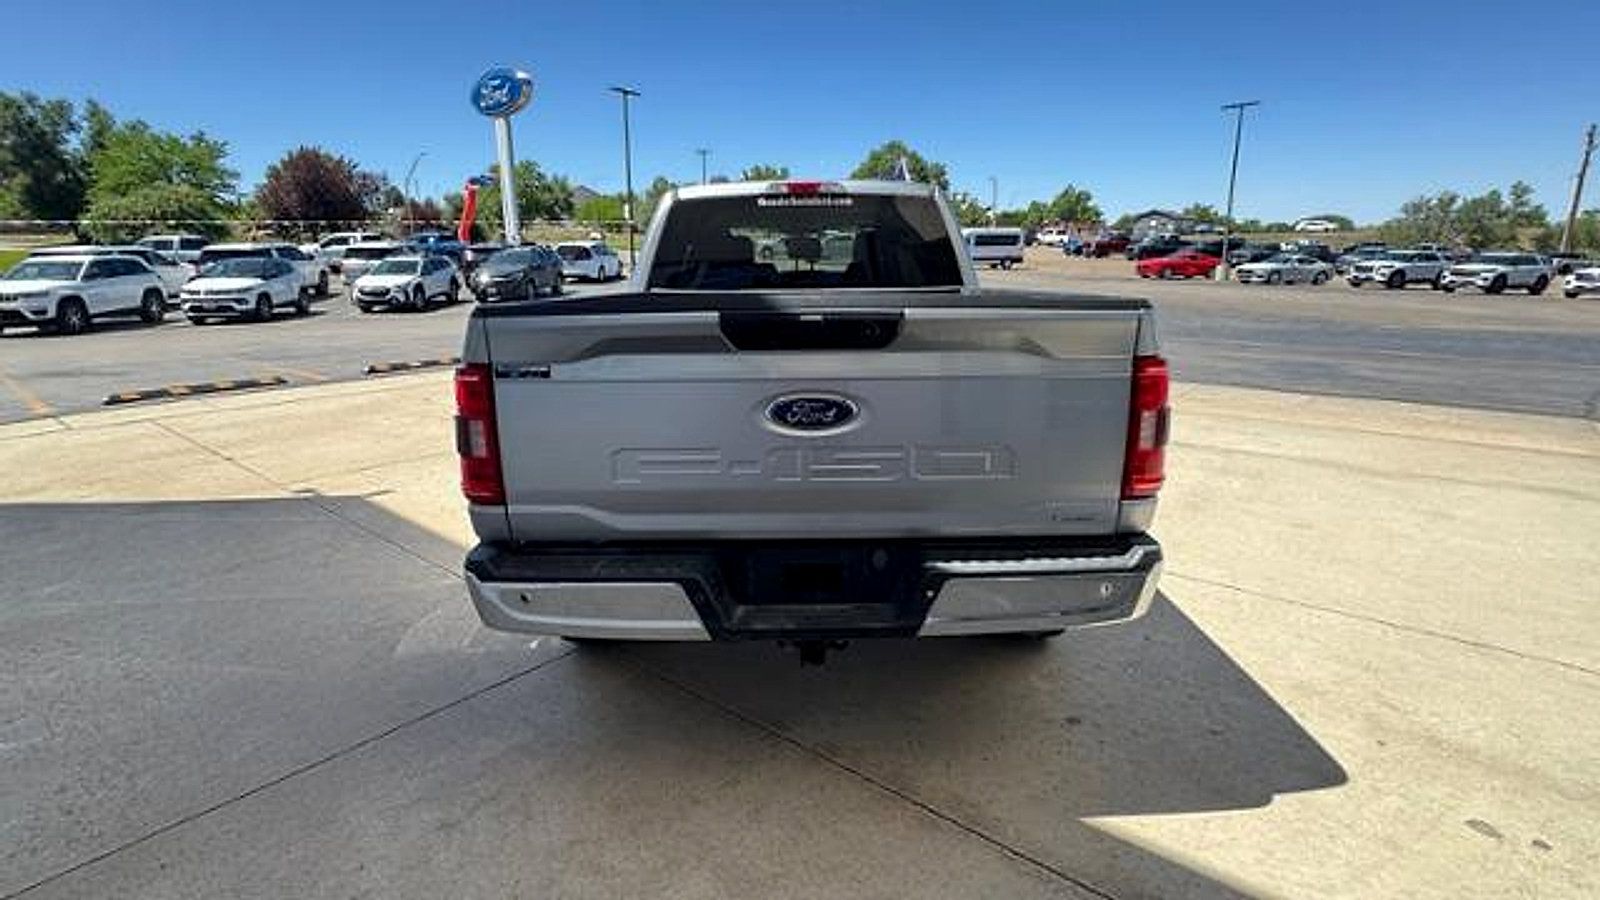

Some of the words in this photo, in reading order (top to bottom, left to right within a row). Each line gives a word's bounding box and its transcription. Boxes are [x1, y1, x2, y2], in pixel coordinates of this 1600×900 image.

[479, 78, 511, 107] Ford
[786, 400, 838, 424] Ford
[609, 443, 1018, 484] F-150
